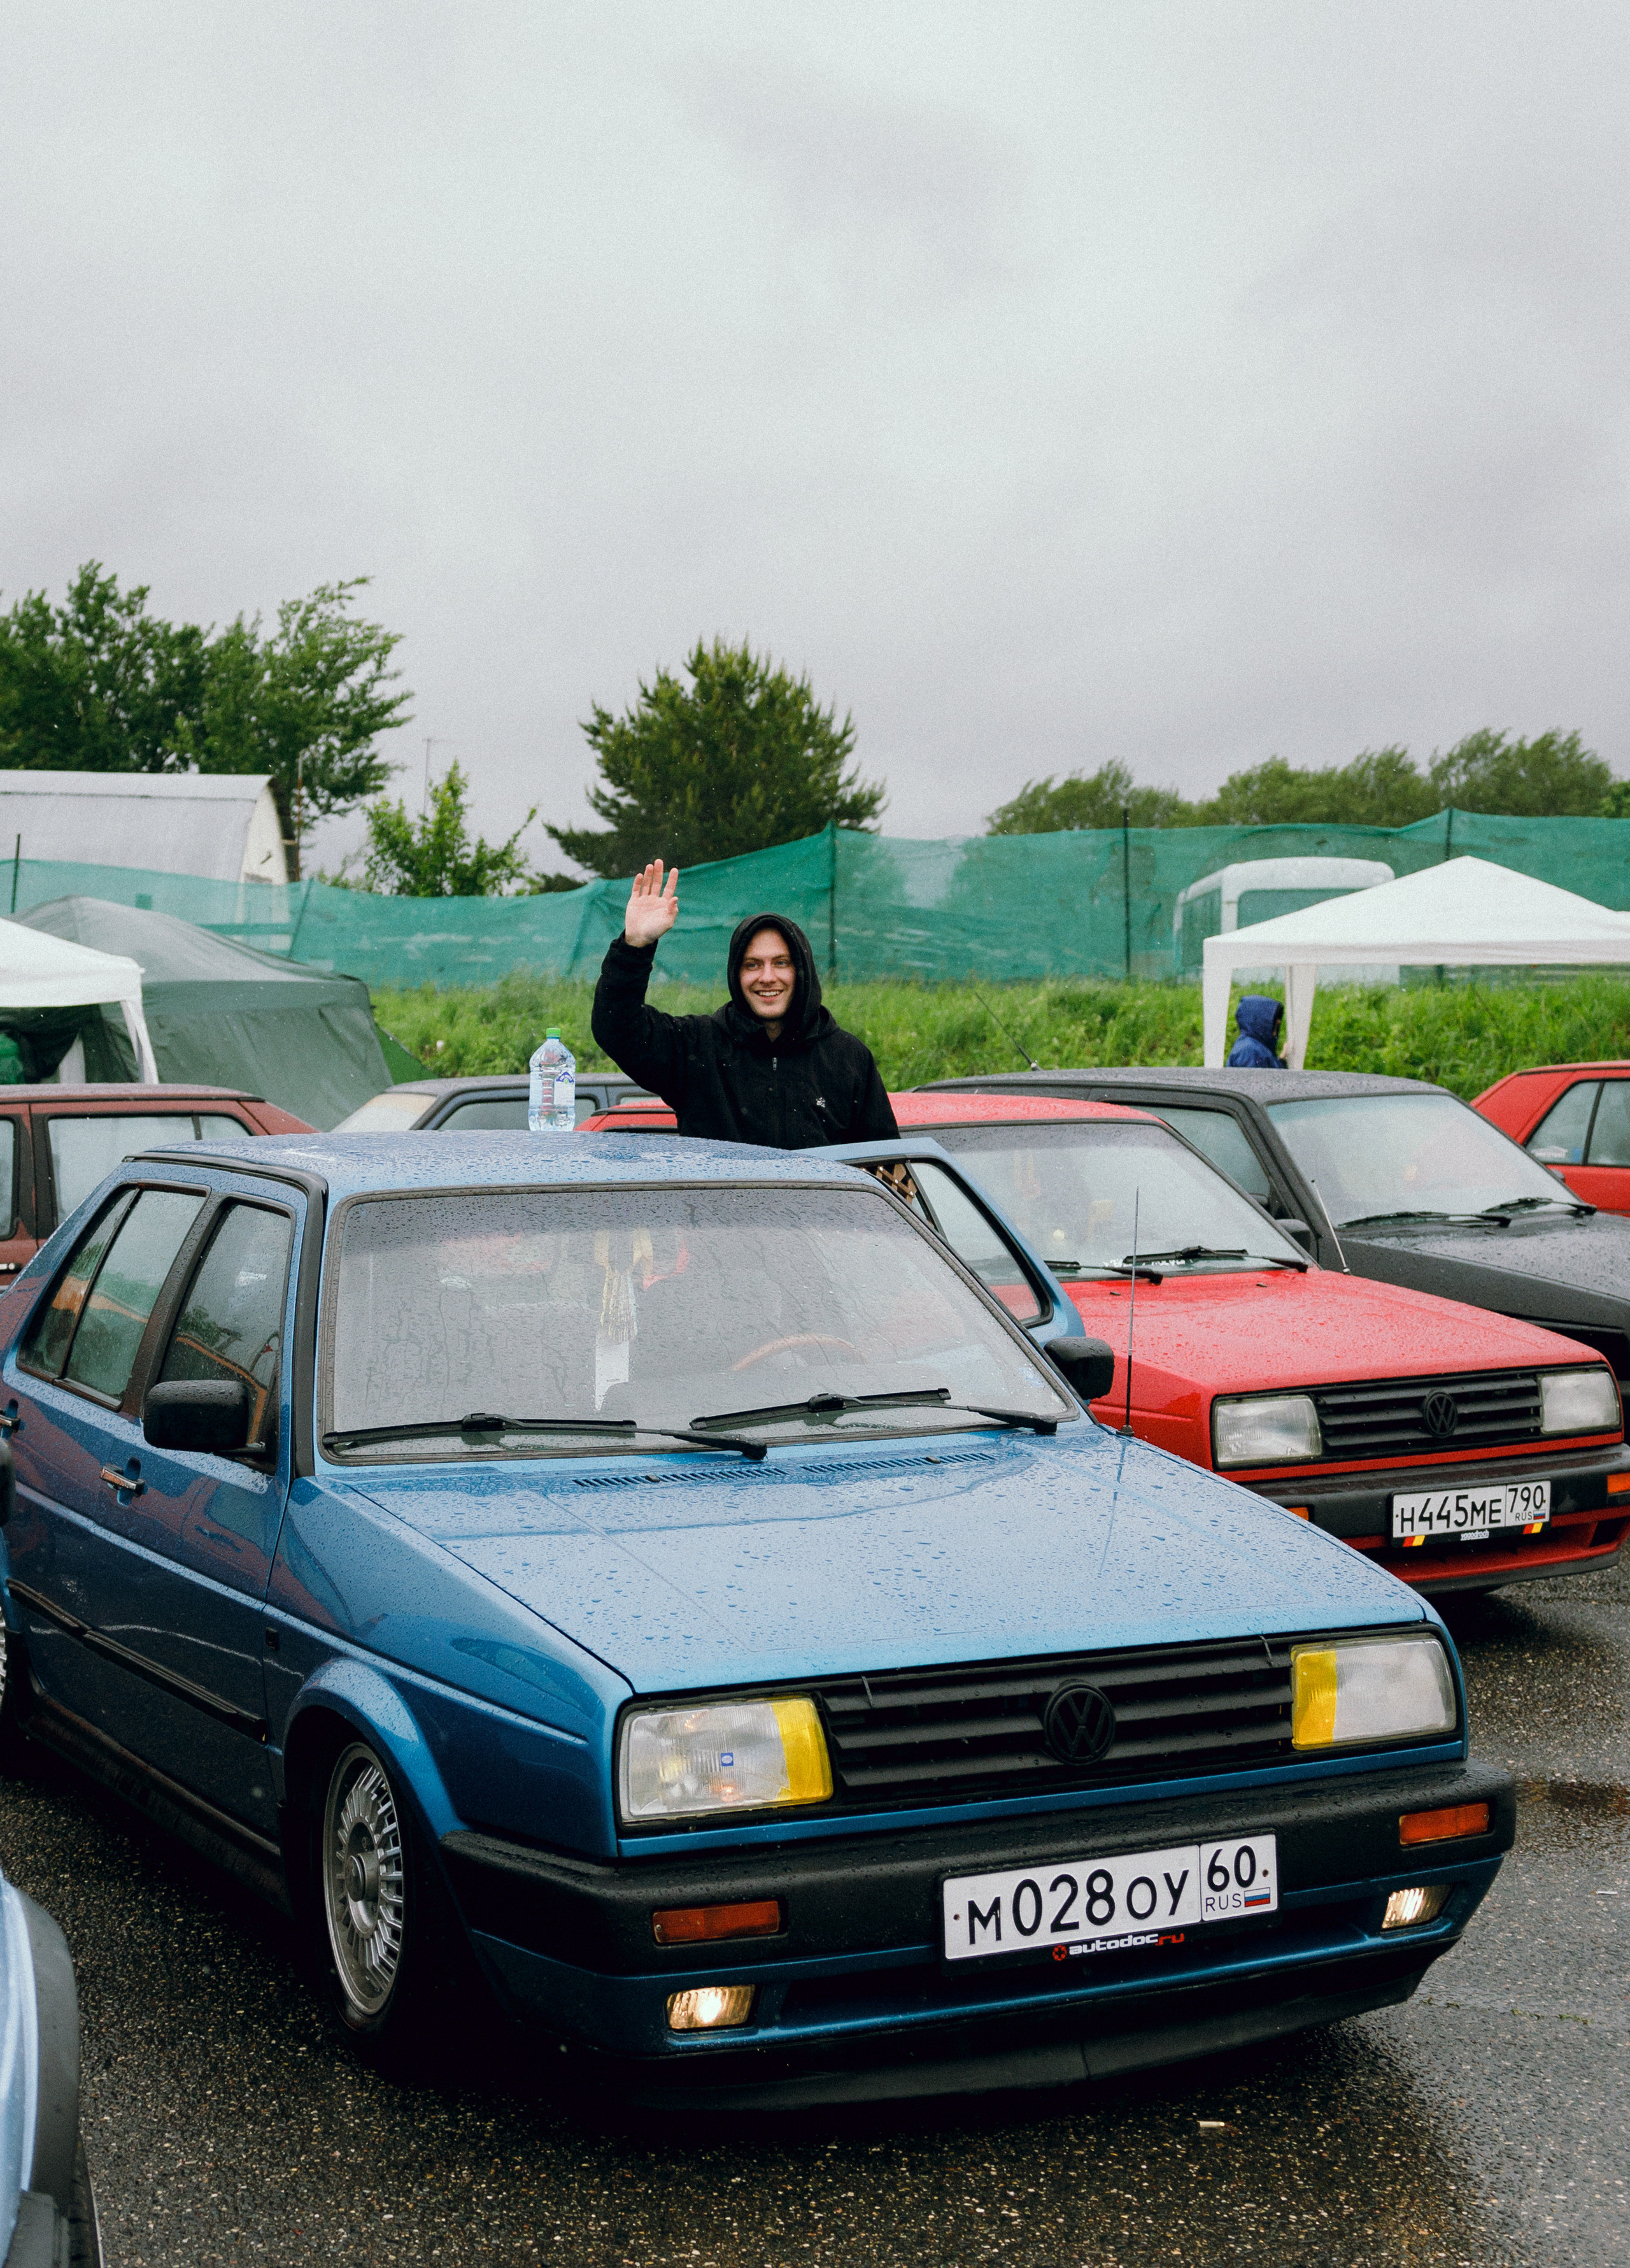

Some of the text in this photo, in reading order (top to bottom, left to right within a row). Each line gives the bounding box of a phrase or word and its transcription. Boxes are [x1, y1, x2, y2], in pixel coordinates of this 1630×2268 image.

[1508, 1485, 1544, 1513] 790
[1515, 1511, 1533, 1522] RUS
[1207, 1844, 1256, 1892] 60
[1205, 1893, 1242, 1913] RUS
[1069, 1932, 1185, 1955] autodoc.ru
